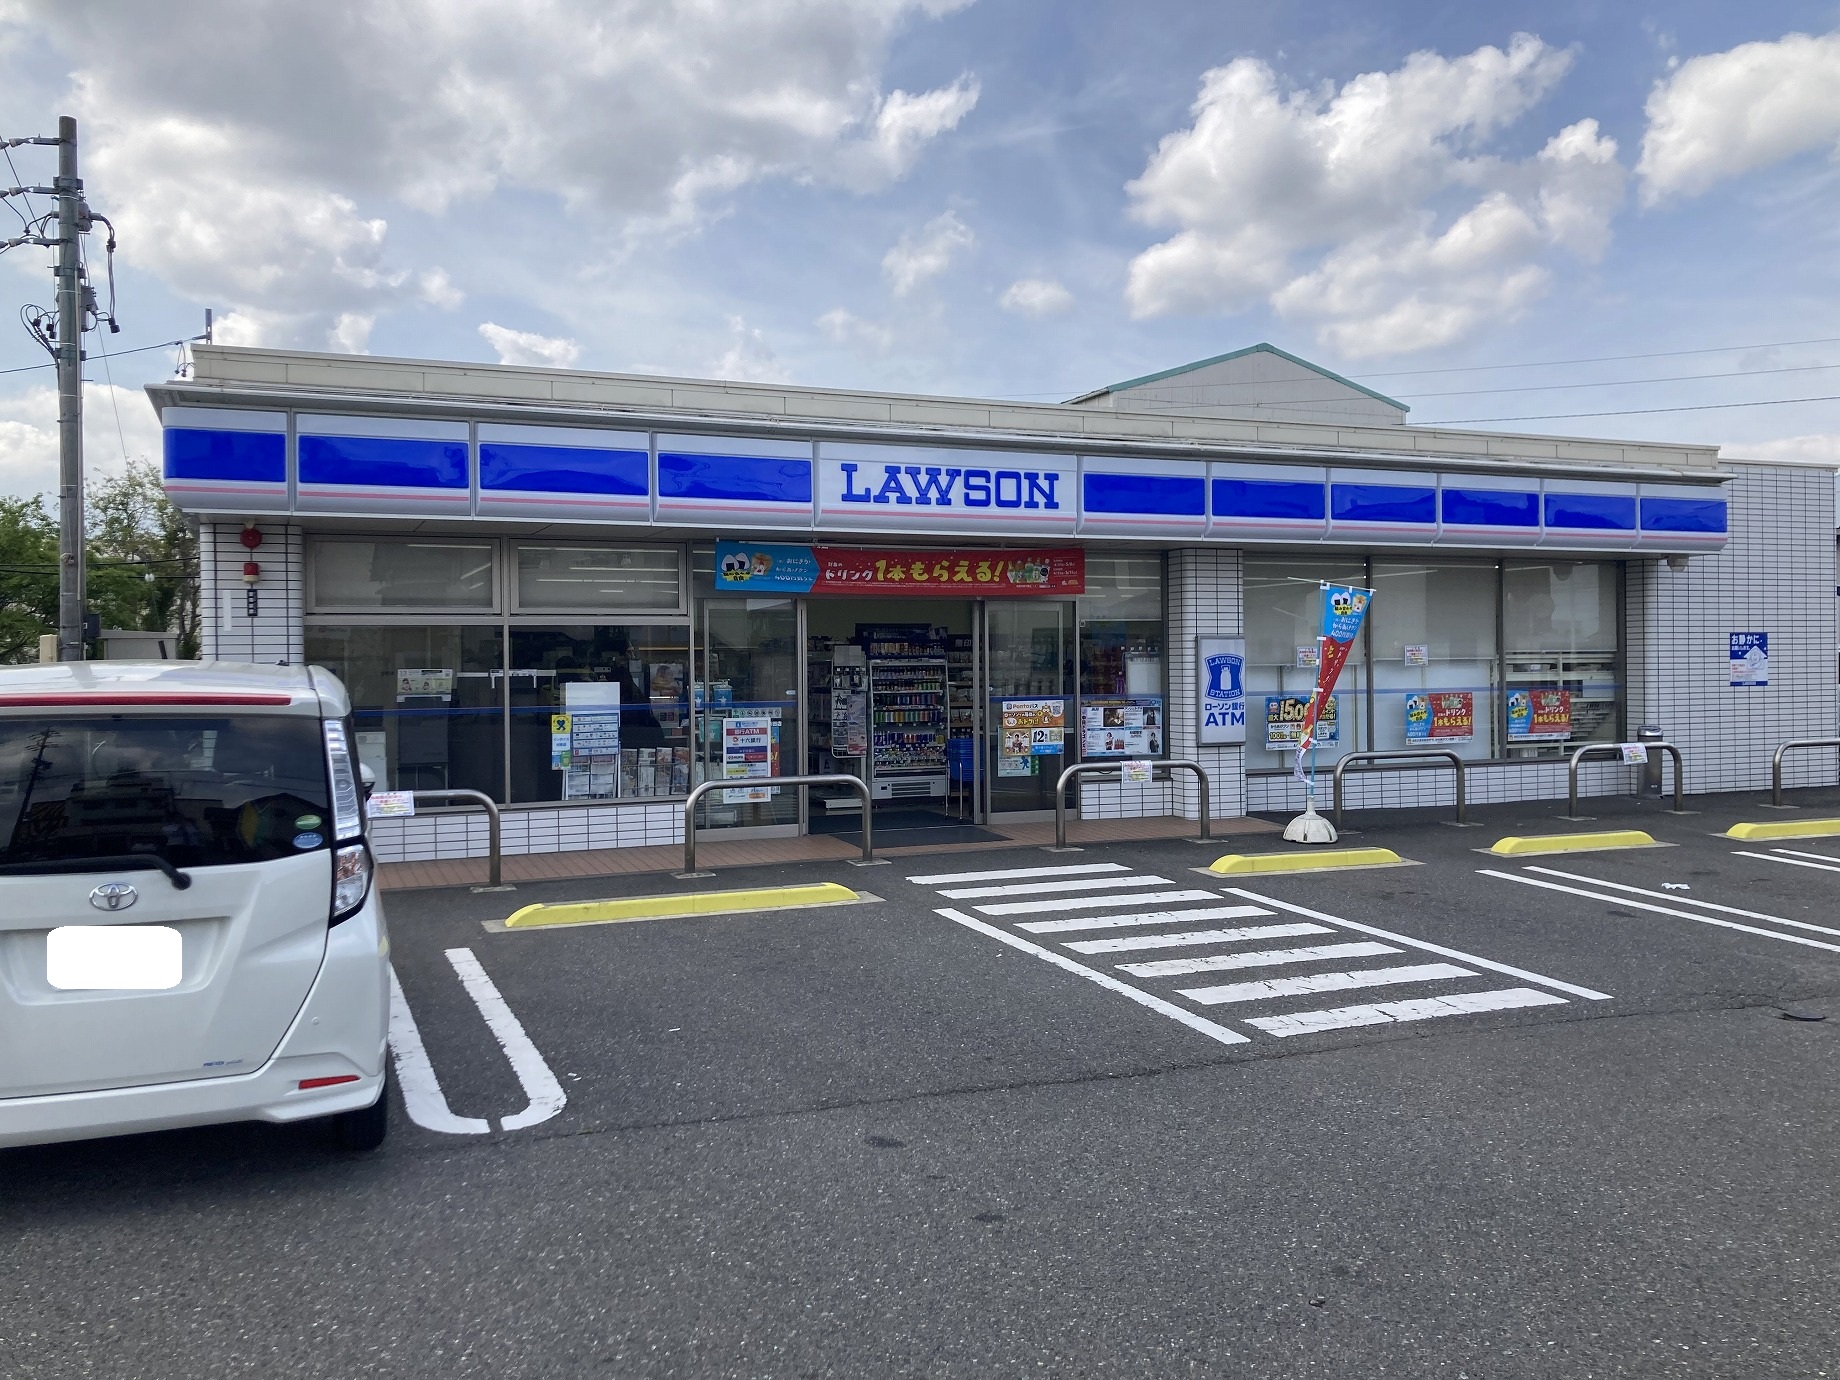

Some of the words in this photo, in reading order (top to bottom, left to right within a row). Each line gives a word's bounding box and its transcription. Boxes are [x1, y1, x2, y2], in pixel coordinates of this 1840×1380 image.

[841, 463, 1059, 509] LAWSON
[1209, 656, 1241, 666] LAWSON
[1210, 688, 1241, 698] STATION
[1205, 702, 1245, 711] ローソン銀行
[1205, 712, 1245, 727] ATM
[1433, 716, 1472, 727] 1本もらえる!
